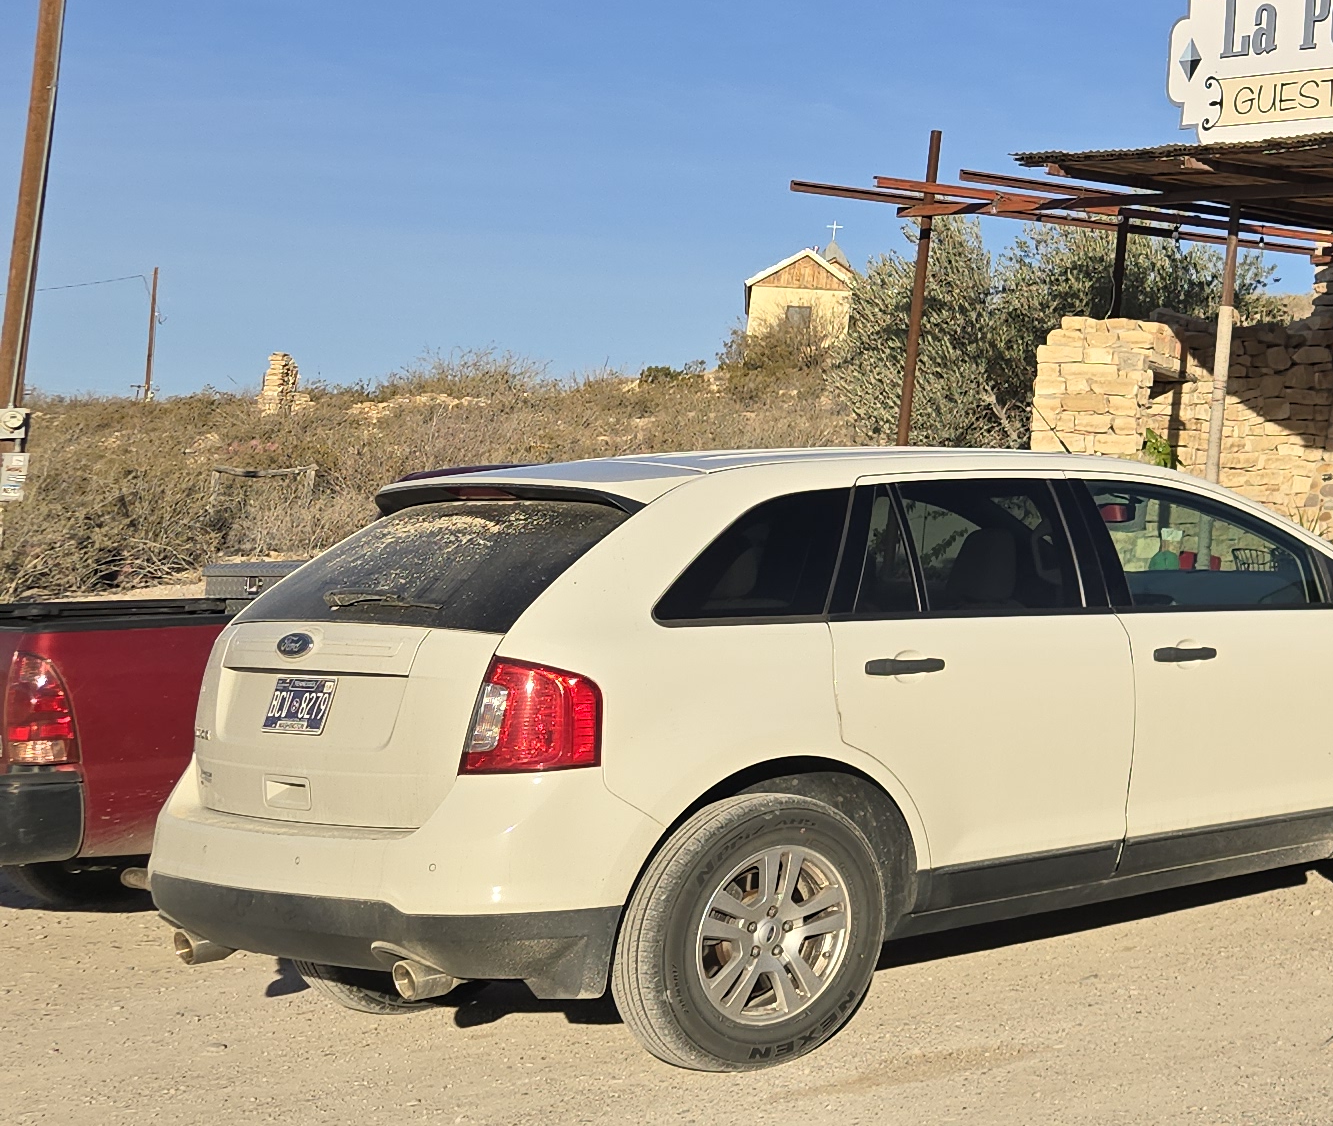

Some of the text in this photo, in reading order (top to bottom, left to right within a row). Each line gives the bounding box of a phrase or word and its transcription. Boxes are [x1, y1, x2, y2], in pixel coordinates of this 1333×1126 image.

[280, 635, 303, 652] Ford
[267, 690, 329, 720] BCV 8279
[746, 989, 857, 1061] NEXEN
